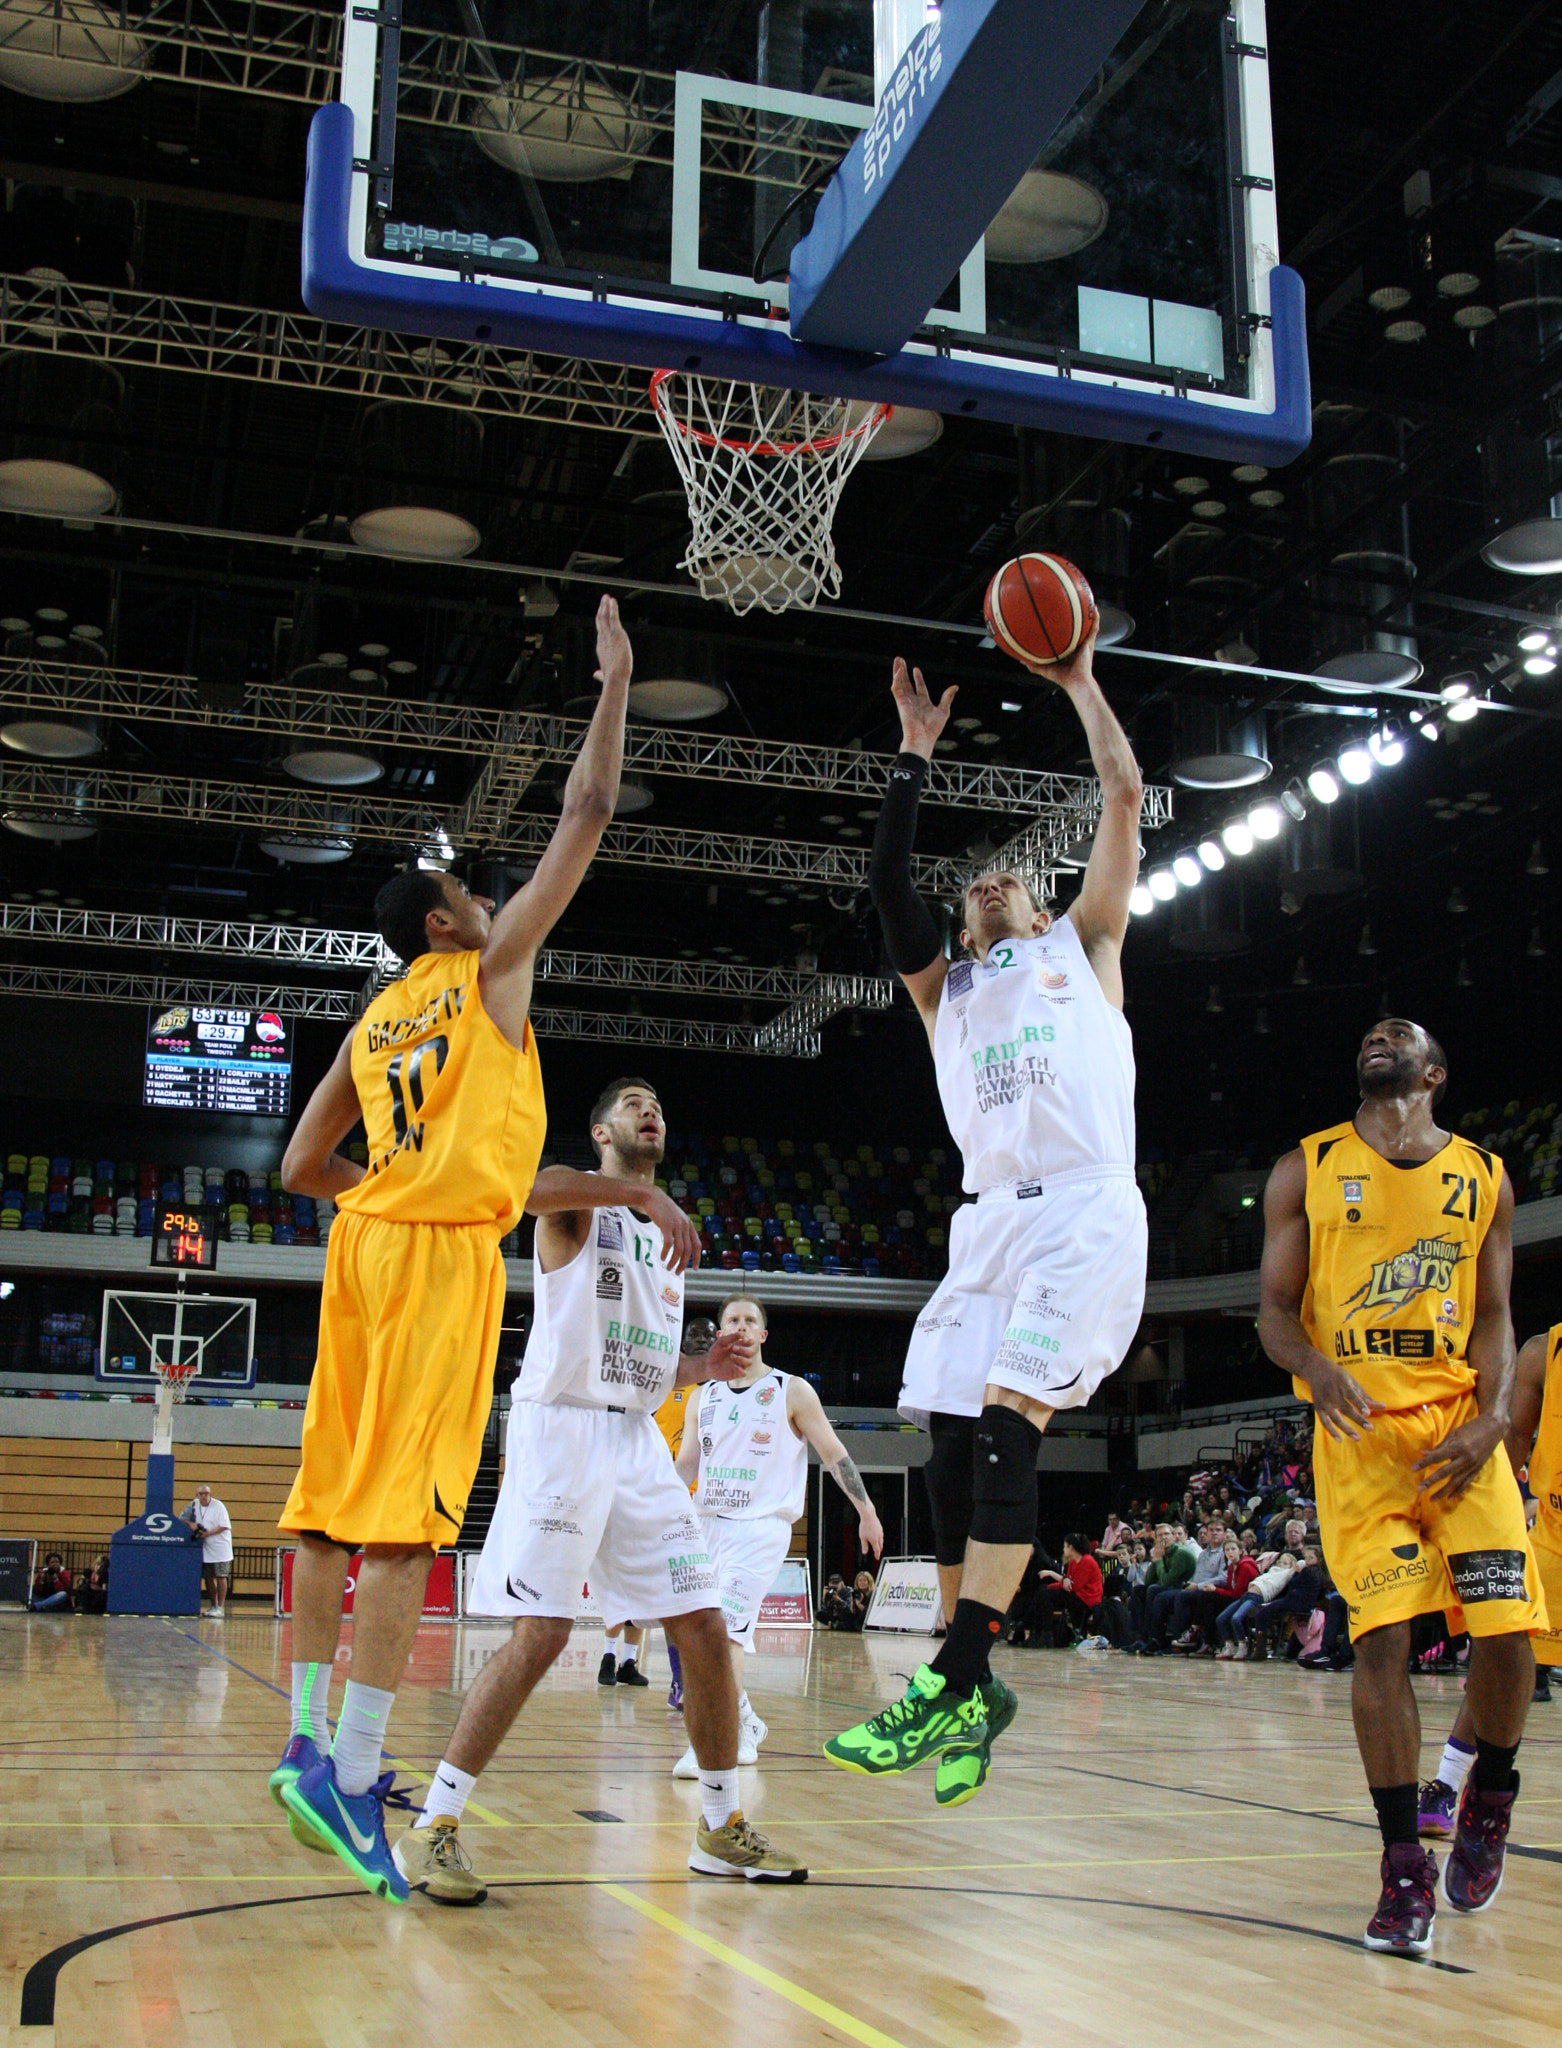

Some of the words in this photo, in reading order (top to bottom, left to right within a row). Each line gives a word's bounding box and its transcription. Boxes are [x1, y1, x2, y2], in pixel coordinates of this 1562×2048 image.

[995, 948, 1017, 968] 2
[971, 1025, 1055, 1070] RAIDRS
[974, 1060, 1015, 1083] WITH
[387, 1035, 448, 1145] 10
[1441, 1173, 1477, 1222] 21
[164, 1212, 199, 1233] 29.6
[178, 1234, 203, 1264] 14
[634, 1233, 653, 1267] 12
[1417, 1239, 1459, 1261] LONDON
[1335, 1328, 1361, 1358] GLL
[602, 1353, 665, 1380] PLYOUTH
[728, 1404, 739, 1424] 4
[705, 1466, 757, 1481] RAIDERS
[0, 1556, 19, 1564] OTEL
[670, 1565, 696, 1577] WITH
[1355, 1557, 1430, 1592] urbanest
[514, 1578, 543, 1601] SPALDING
[888, 1581, 938, 1601] activinstinct
[1458, 1585, 1485, 1597] Prince
